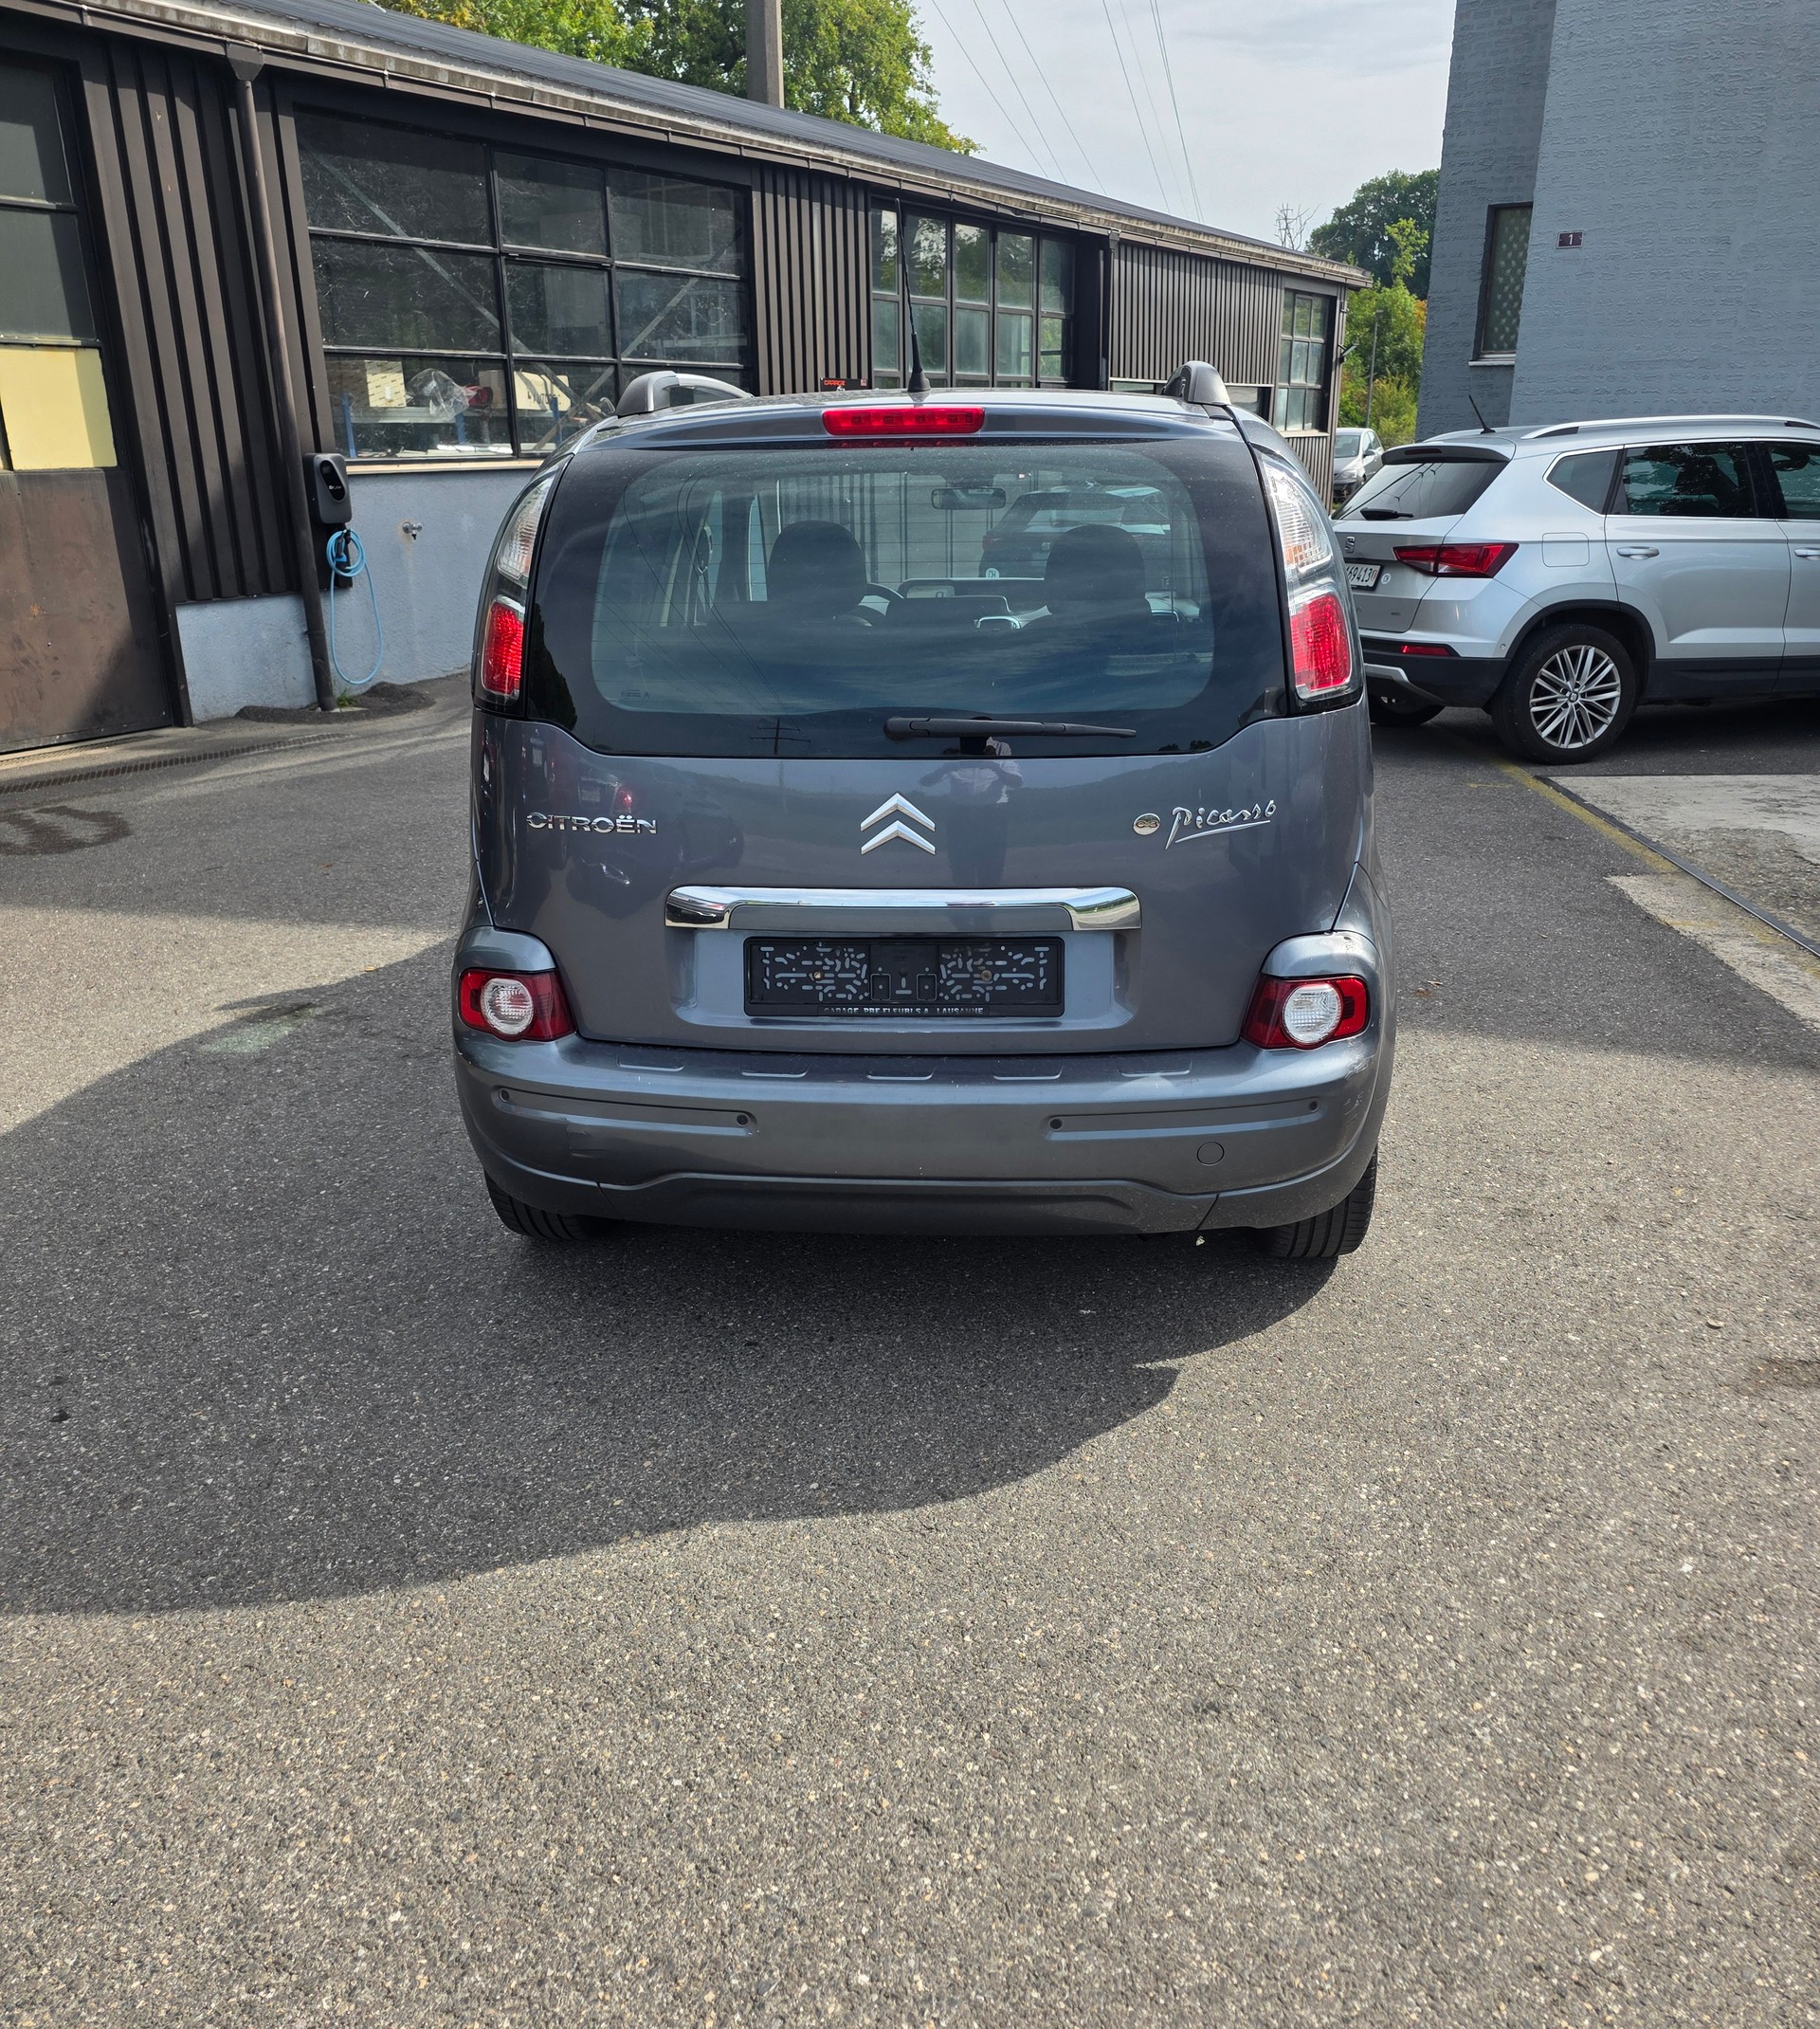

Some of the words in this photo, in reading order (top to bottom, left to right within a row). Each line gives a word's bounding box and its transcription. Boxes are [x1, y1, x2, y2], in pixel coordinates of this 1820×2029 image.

[1569, 234, 1574, 246] 1
[526, 812, 657, 834] CITROËN
[1165, 799, 1277, 850] Picasso
